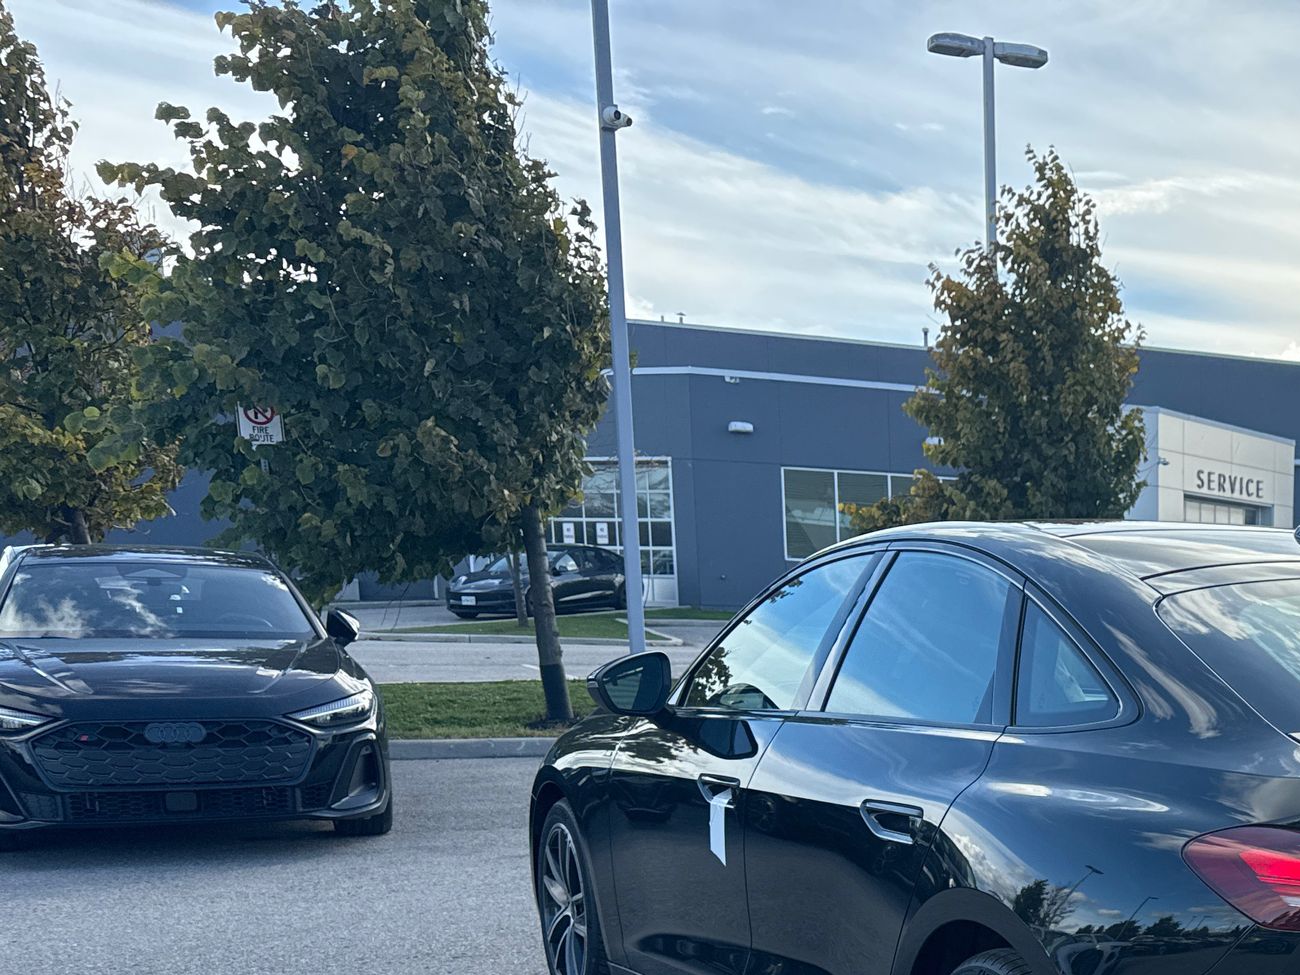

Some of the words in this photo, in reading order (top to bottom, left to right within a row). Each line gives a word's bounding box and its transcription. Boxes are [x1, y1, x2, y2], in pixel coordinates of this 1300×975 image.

[252, 426, 270, 434] FIRE
[249, 434, 274, 442] ROUTE
[1196, 469, 1264, 498] SERVICE
